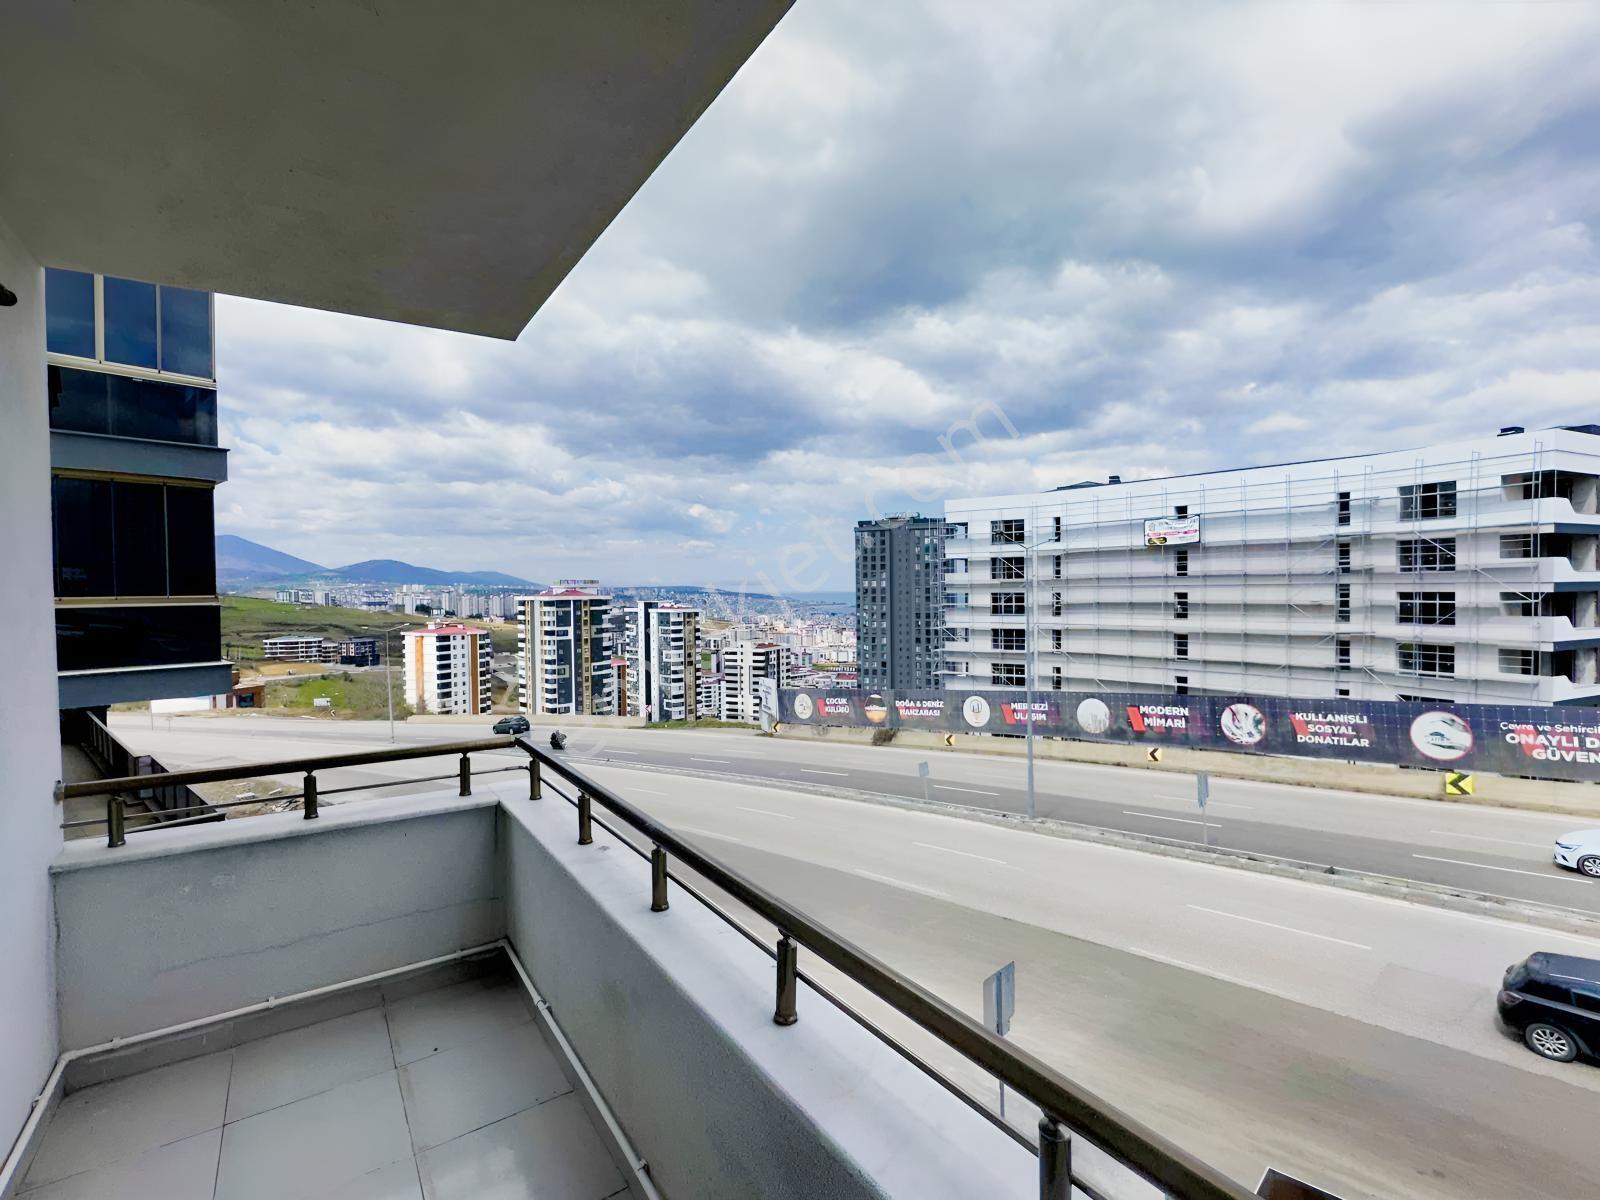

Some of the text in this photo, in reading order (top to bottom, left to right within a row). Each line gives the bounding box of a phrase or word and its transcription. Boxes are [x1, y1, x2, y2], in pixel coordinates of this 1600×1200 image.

[1139, 705, 1189, 716] MODERN
[1143, 716, 1185, 728] MİMARİ
[1295, 712, 1368, 725] KULLANIŞLI
[1307, 723, 1356, 735] SOSYAL
[1536, 724, 1552, 732] ve
[1296, 734, 1370, 747] DONATILAR
[1505, 733, 1579, 747] ONAYLI
